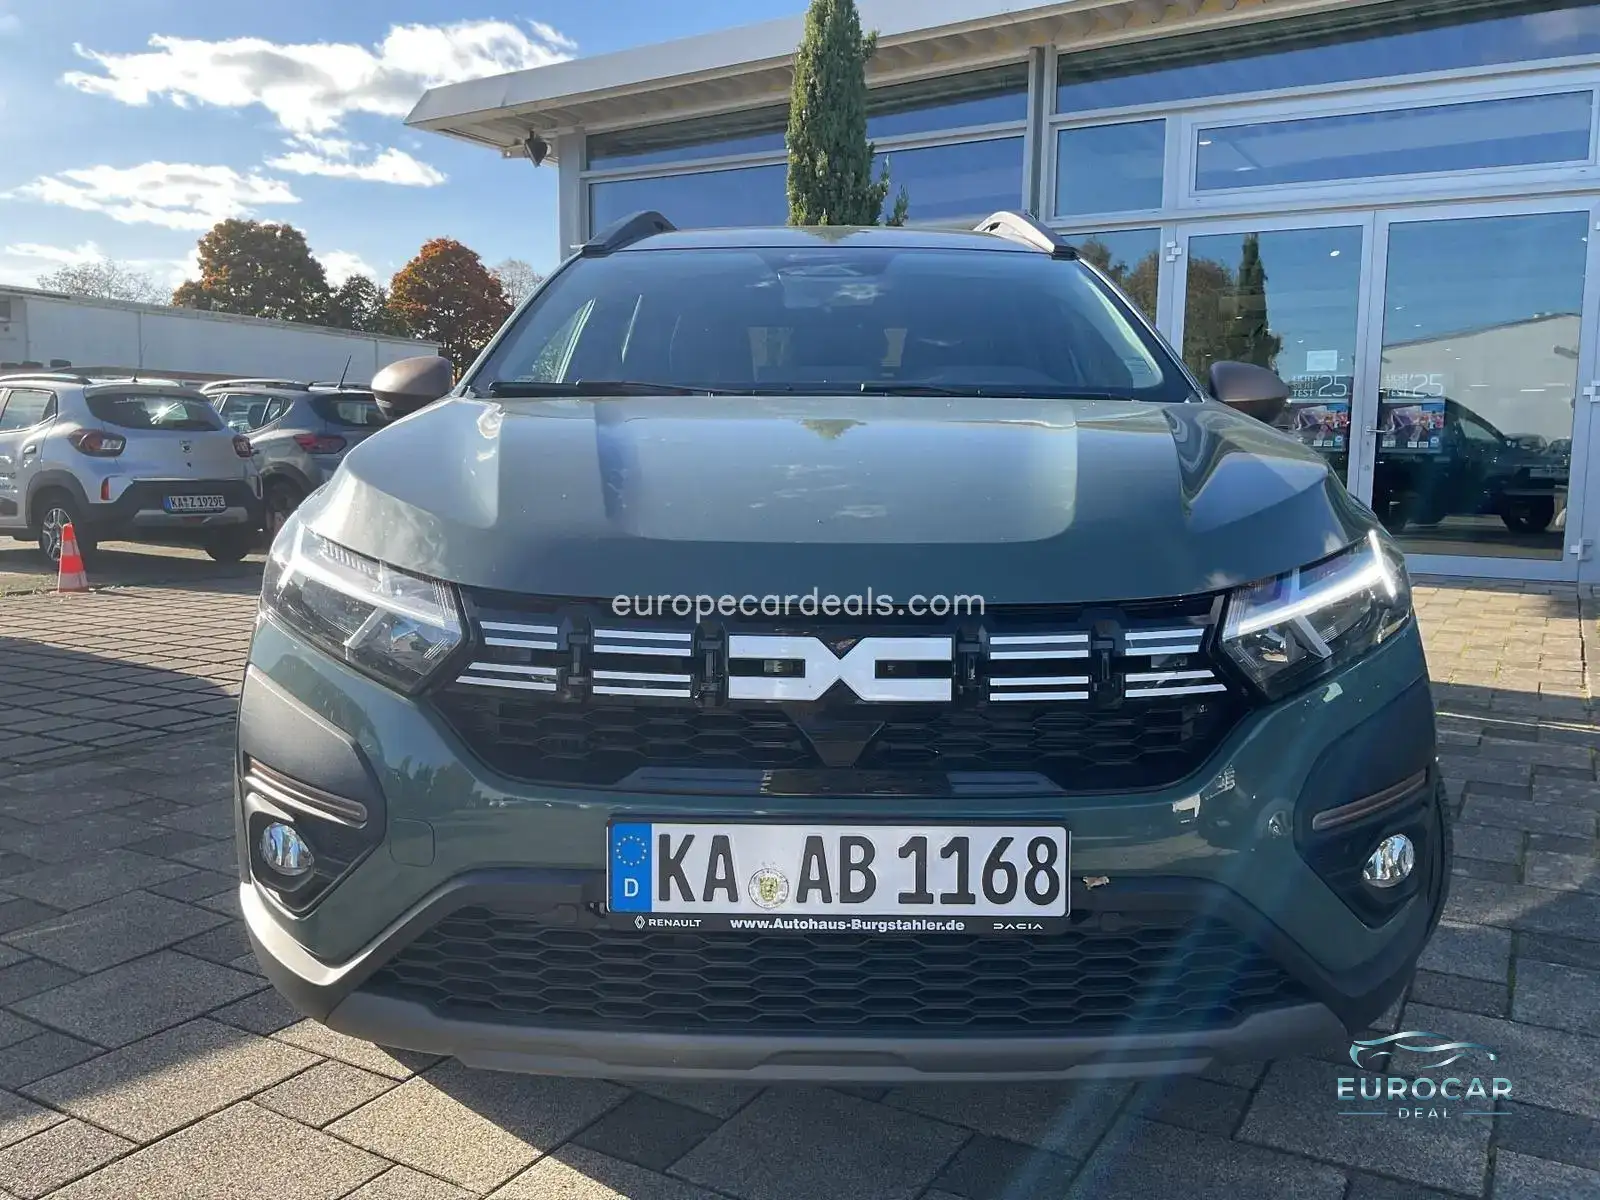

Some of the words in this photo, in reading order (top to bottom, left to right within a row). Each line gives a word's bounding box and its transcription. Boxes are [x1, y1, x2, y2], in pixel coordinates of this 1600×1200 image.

[1292, 389, 1315, 397] TEST
[1386, 388, 1409, 397] TEST
[171, 496, 184, 508] KA
[189, 496, 197, 508] Z
[198, 496, 225, 507] 1929E
[624, 878, 639, 897] D
[658, 833, 739, 902] KA
[796, 835, 878, 904] AB
[897, 836, 1059, 906] 1168
[648, 918, 702, 927] RENAULT
[730, 917, 965, 933] www.Autohaus-Burgstahler.de
[993, 922, 1044, 930] DACIA
